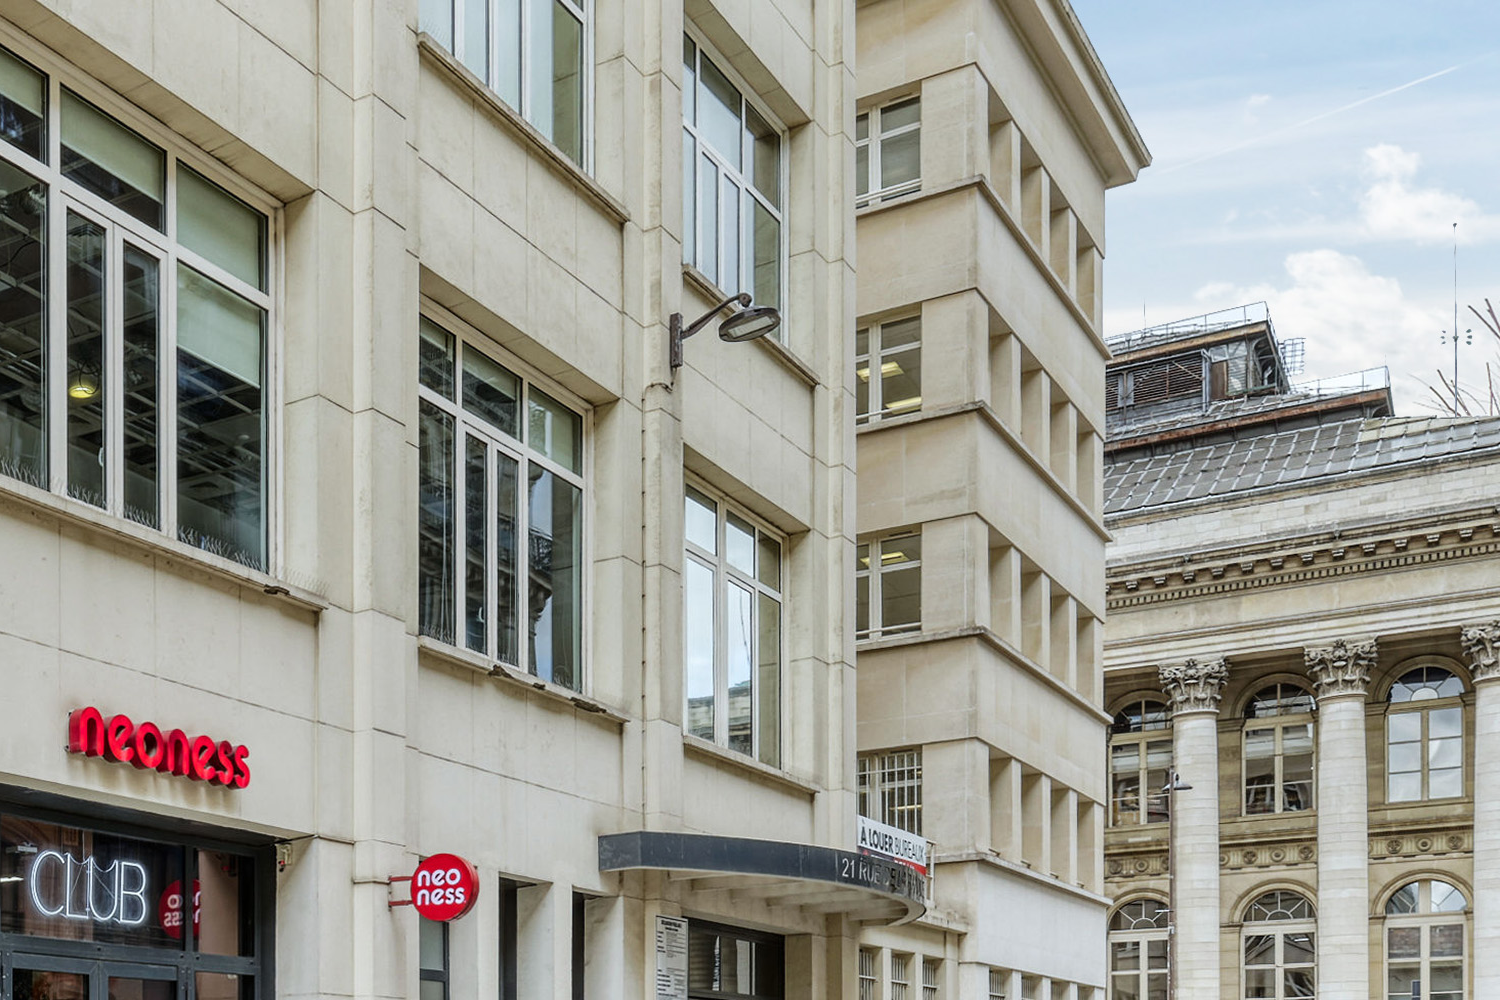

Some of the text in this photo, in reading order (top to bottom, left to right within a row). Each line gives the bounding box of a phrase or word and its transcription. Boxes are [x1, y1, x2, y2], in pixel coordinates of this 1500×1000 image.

[69, 706, 251, 789] neoness
[869, 828, 894, 854] LOUER
[417, 868, 461, 887] neo
[841, 857, 855, 879] 21
[30, 849, 147, 925] CLUB
[416, 887, 466, 906] ness
